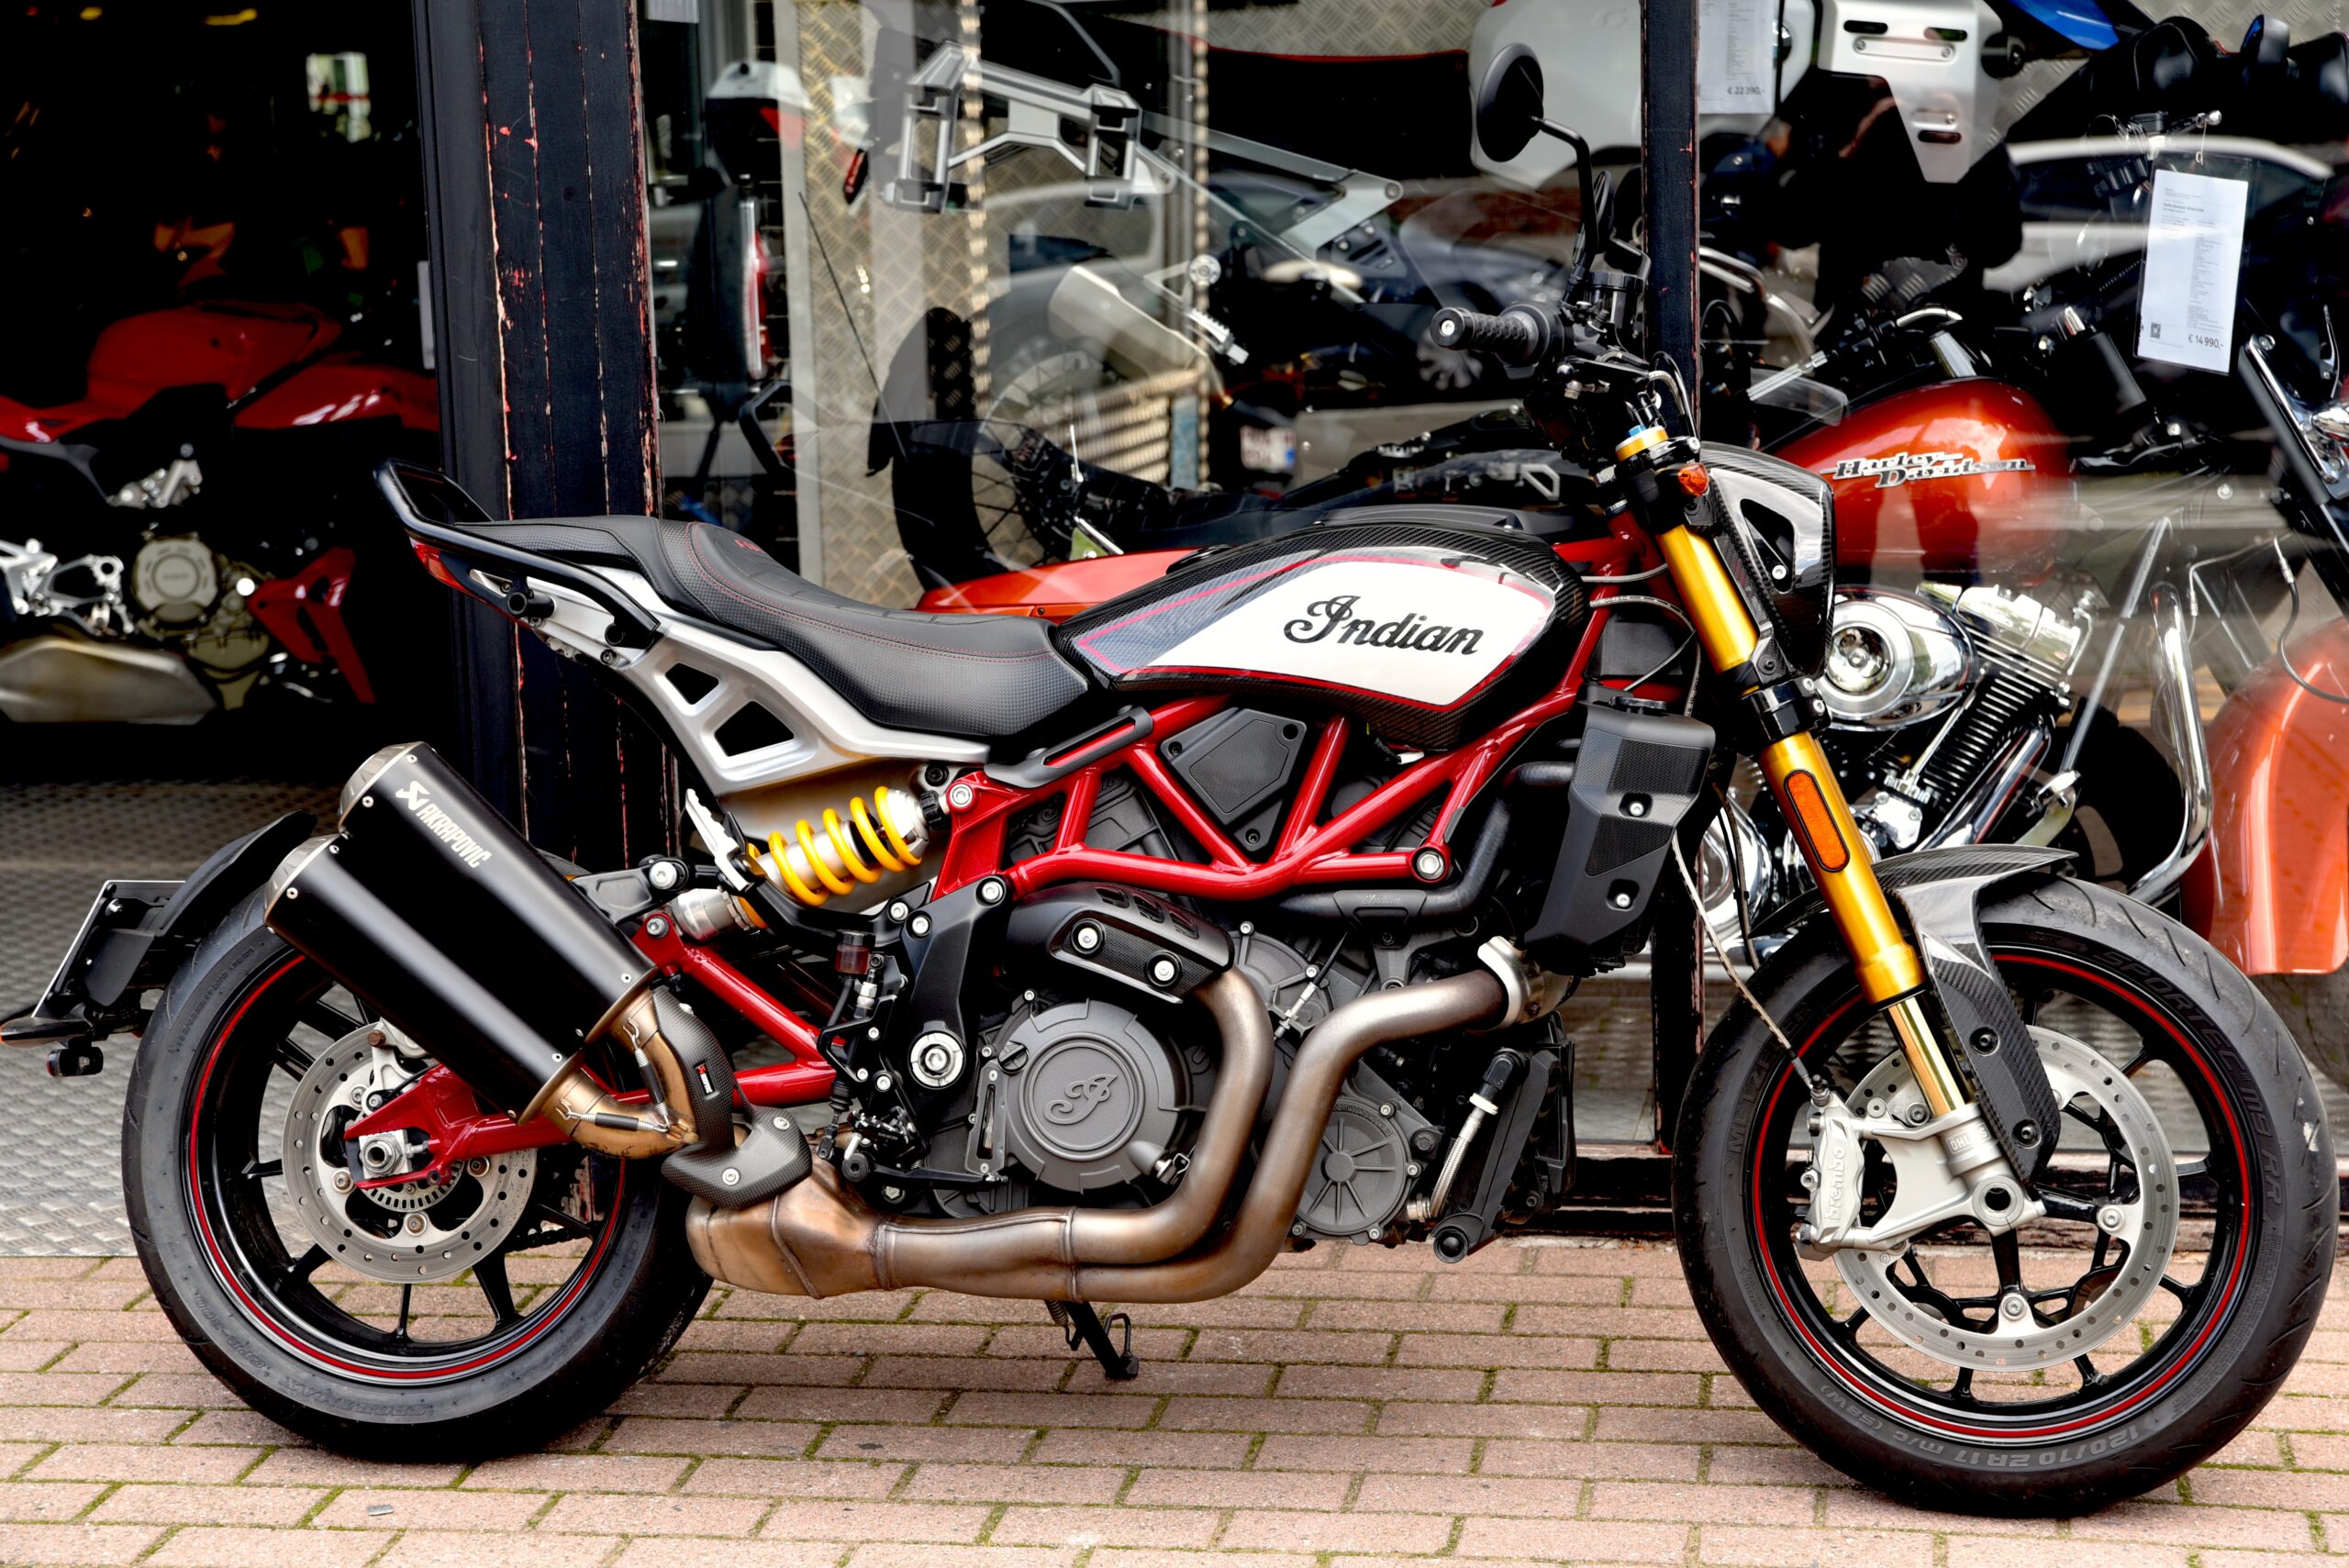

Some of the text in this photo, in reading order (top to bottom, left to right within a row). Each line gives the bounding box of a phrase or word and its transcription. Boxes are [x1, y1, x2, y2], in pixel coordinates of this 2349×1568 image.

[1828, 451, 1960, 480] Harley
[1874, 458, 2034, 488] Davidson
[1283, 595, 1485, 655] Indian
[1949, 1125, 1988, 1151] ÖHLS
[1824, 1145, 1846, 1222] brembo
[1819, 1384, 1885, 1432] (58W)
[2038, 1423, 2140, 1468] 120/70
